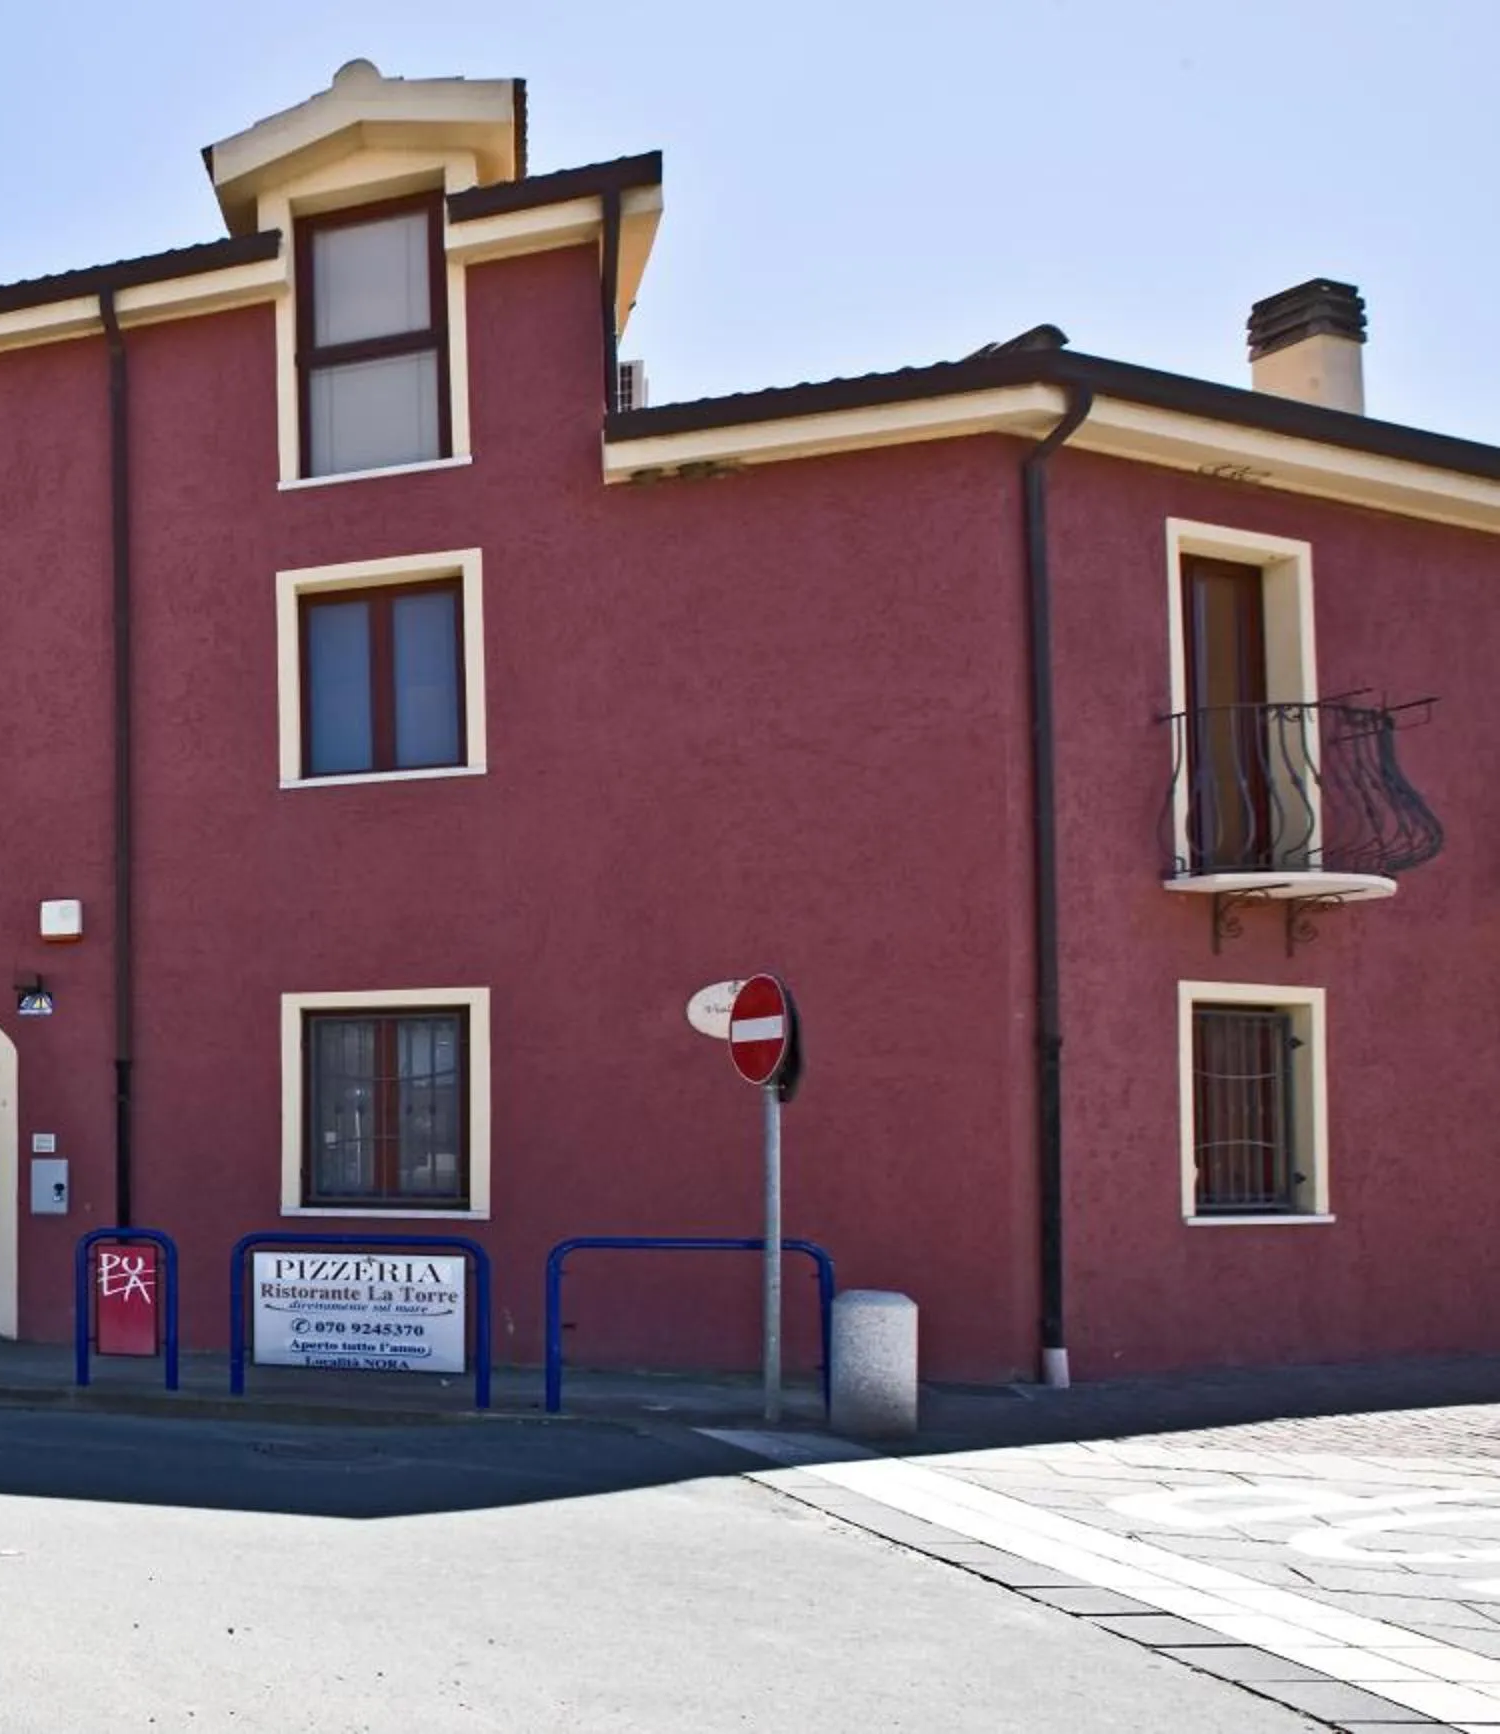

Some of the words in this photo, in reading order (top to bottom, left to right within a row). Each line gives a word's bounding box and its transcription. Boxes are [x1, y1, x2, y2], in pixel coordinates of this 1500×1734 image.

[275, 1259, 441, 1283] PIZZERIA
[260, 1283, 361, 1301] Ristorante
[368, 1285, 394, 1302] La
[399, 1286, 459, 1304] Torre
[395, 1305, 429, 1314] mare
[314, 1321, 346, 1334] 070
[351, 1322, 425, 1337] 9245370
[291, 1339, 339, 1352] Aperto
[341, 1341, 376, 1352] tutto
[364, 1358, 411, 1370] NORA
